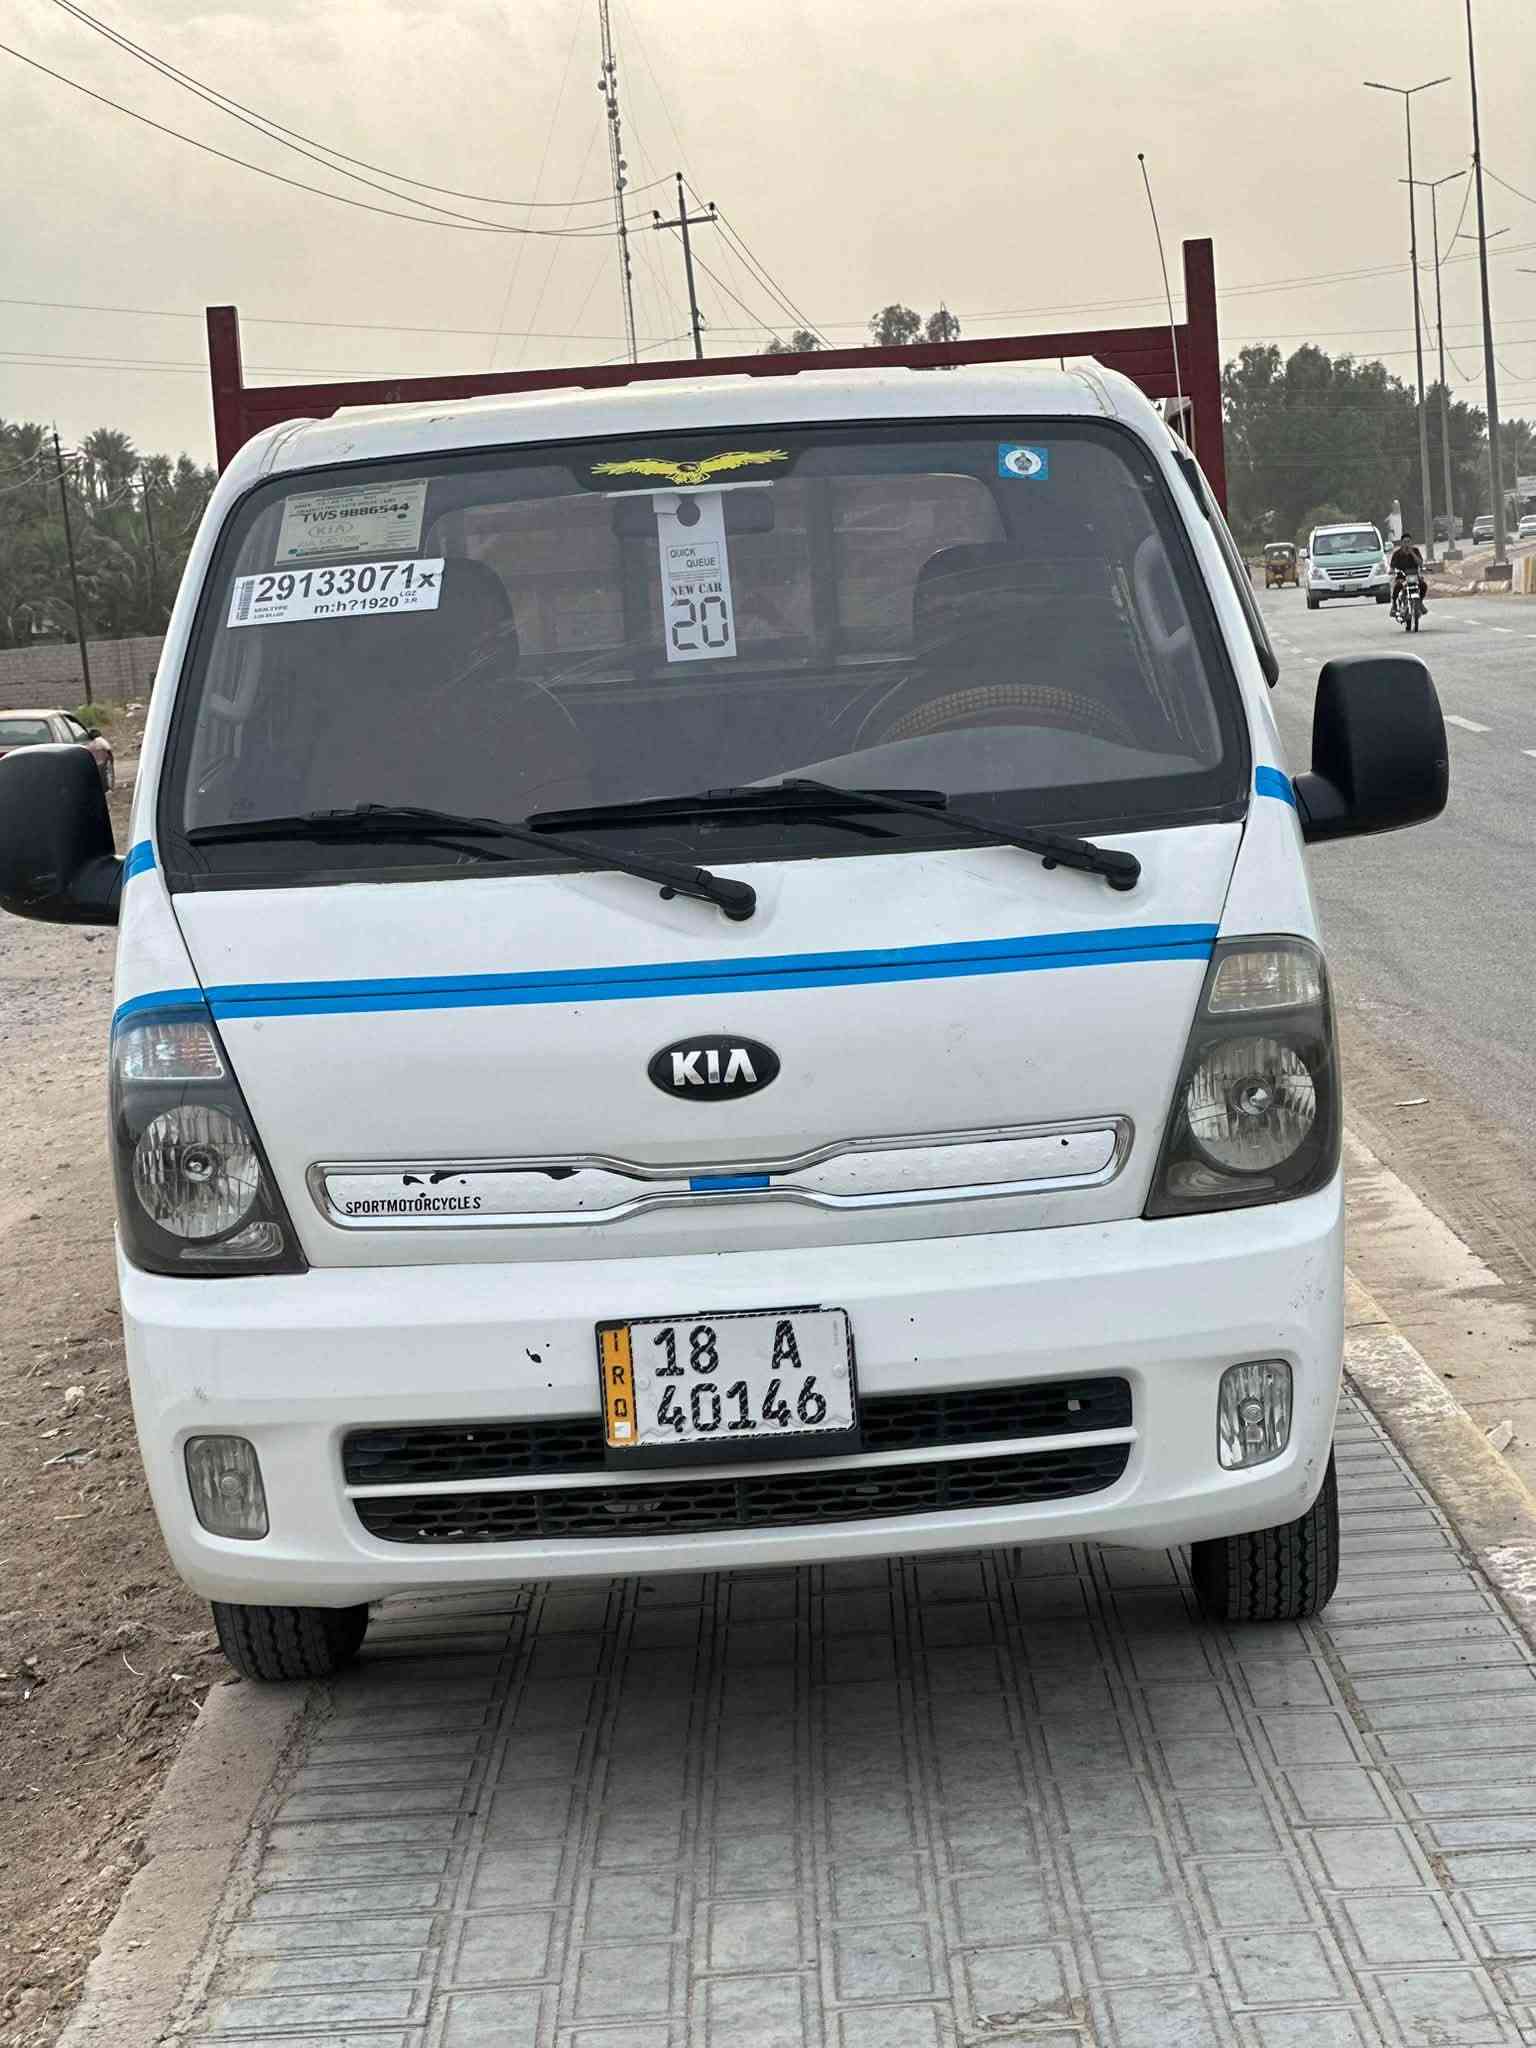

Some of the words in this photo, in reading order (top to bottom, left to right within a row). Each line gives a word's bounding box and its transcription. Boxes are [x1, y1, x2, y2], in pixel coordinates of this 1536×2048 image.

[671, 548, 696, 558] QUICK
[686, 557, 716, 567] QUEUE
[671, 585, 694, 595] NEW
[698, 583, 722, 593] CAR
[670, 596, 729, 650] 20
[670, 1048, 758, 1086] KIA
[653, 1324, 720, 1377] 18
[771, 1319, 802, 1369] A
[656, 1375, 827, 1433] 40146
